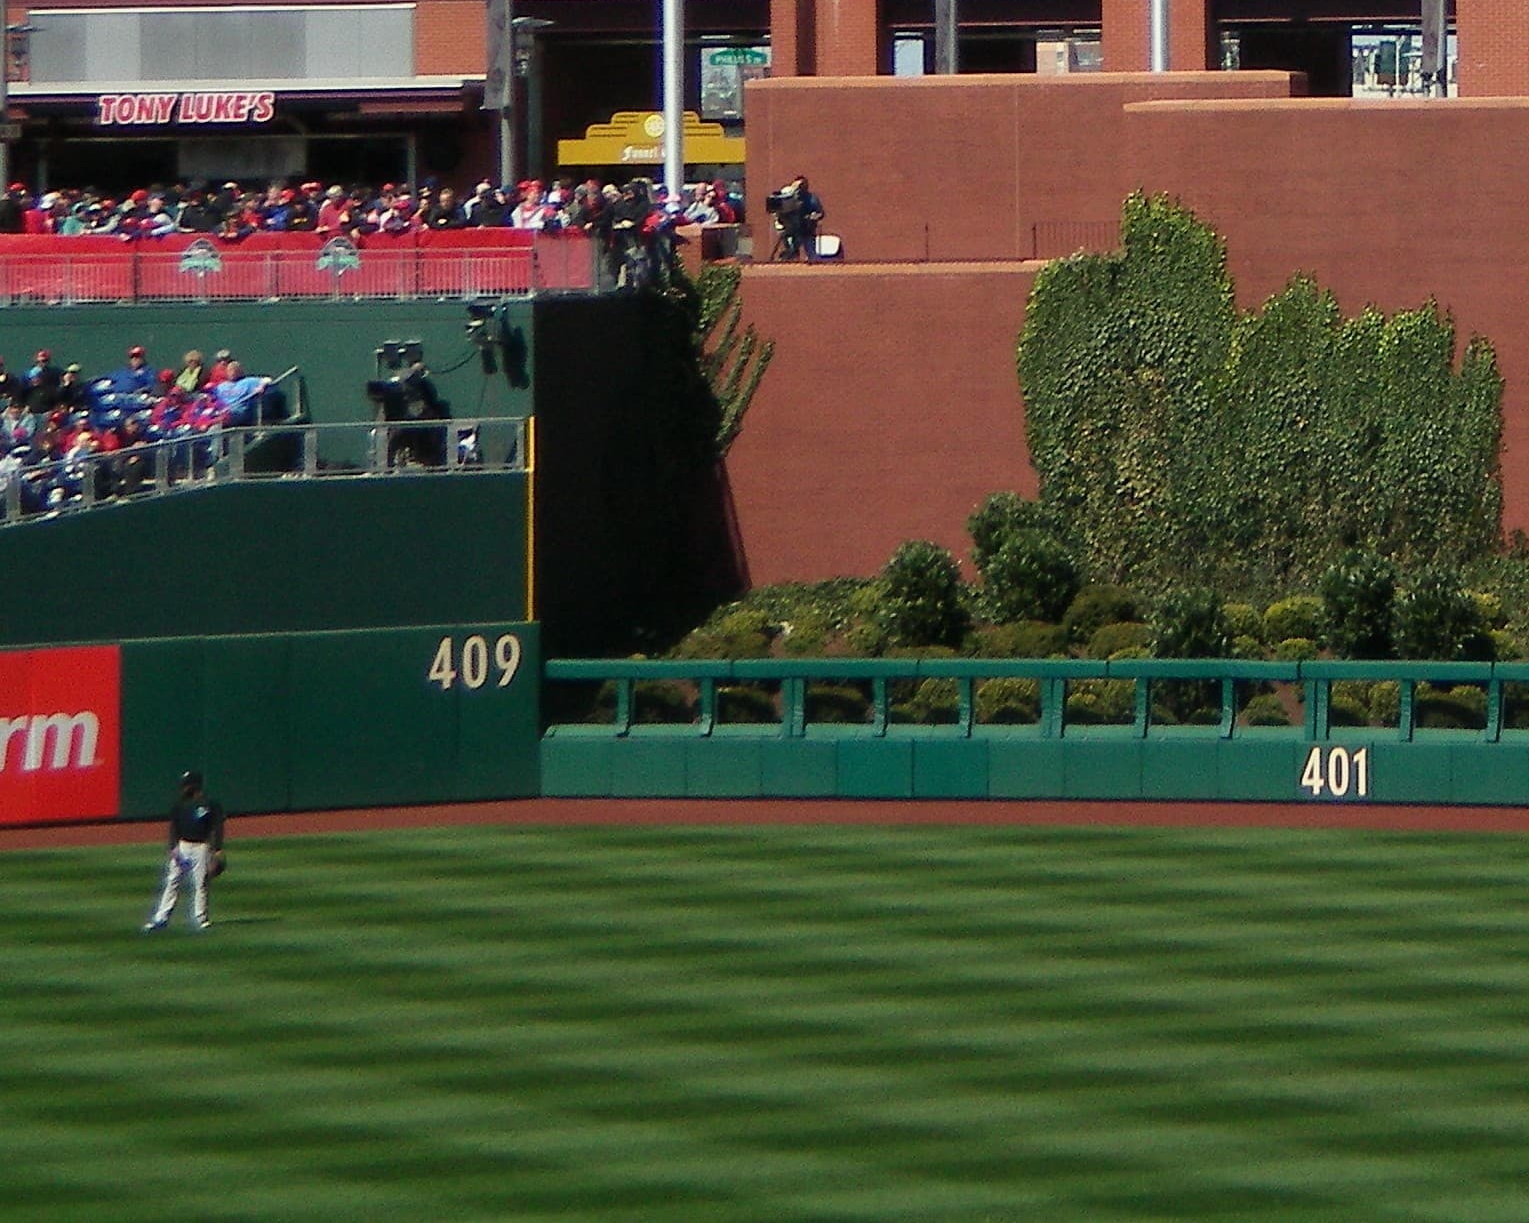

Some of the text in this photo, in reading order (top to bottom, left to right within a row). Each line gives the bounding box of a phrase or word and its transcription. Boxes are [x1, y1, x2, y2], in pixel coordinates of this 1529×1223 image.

[99, 92, 275, 124] TONY LUKE'S
[429, 632, 521, 690] 409
[1301, 746, 1368, 796] 401
